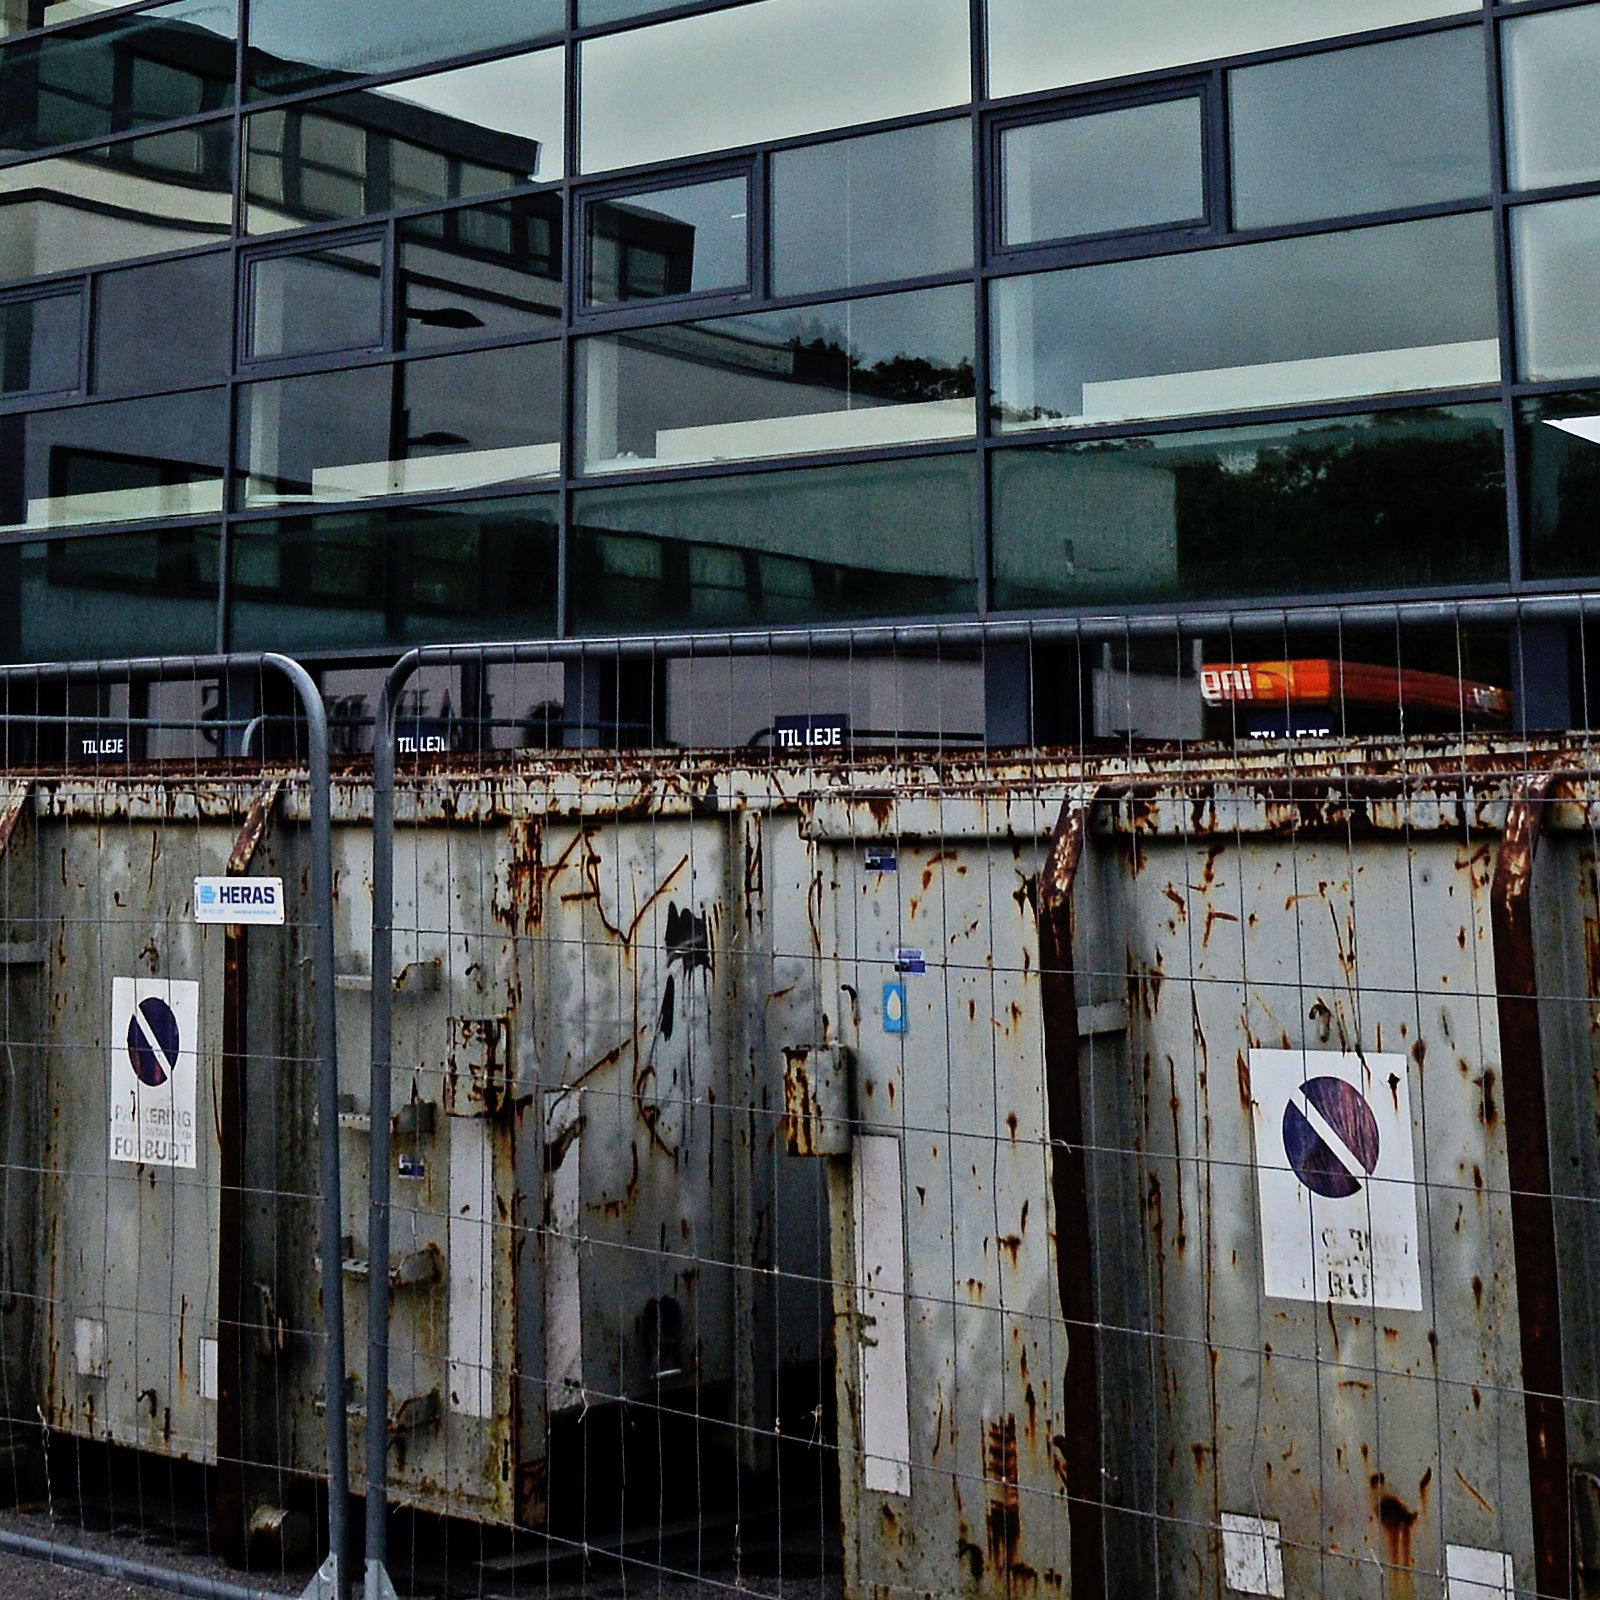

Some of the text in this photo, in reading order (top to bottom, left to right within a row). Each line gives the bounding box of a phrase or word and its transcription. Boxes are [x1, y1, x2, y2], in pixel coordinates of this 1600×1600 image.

[397, 736, 418, 753] TIL
[777, 727, 842, 747] TIL LEJE
[219, 886, 275, 904] HERAS
